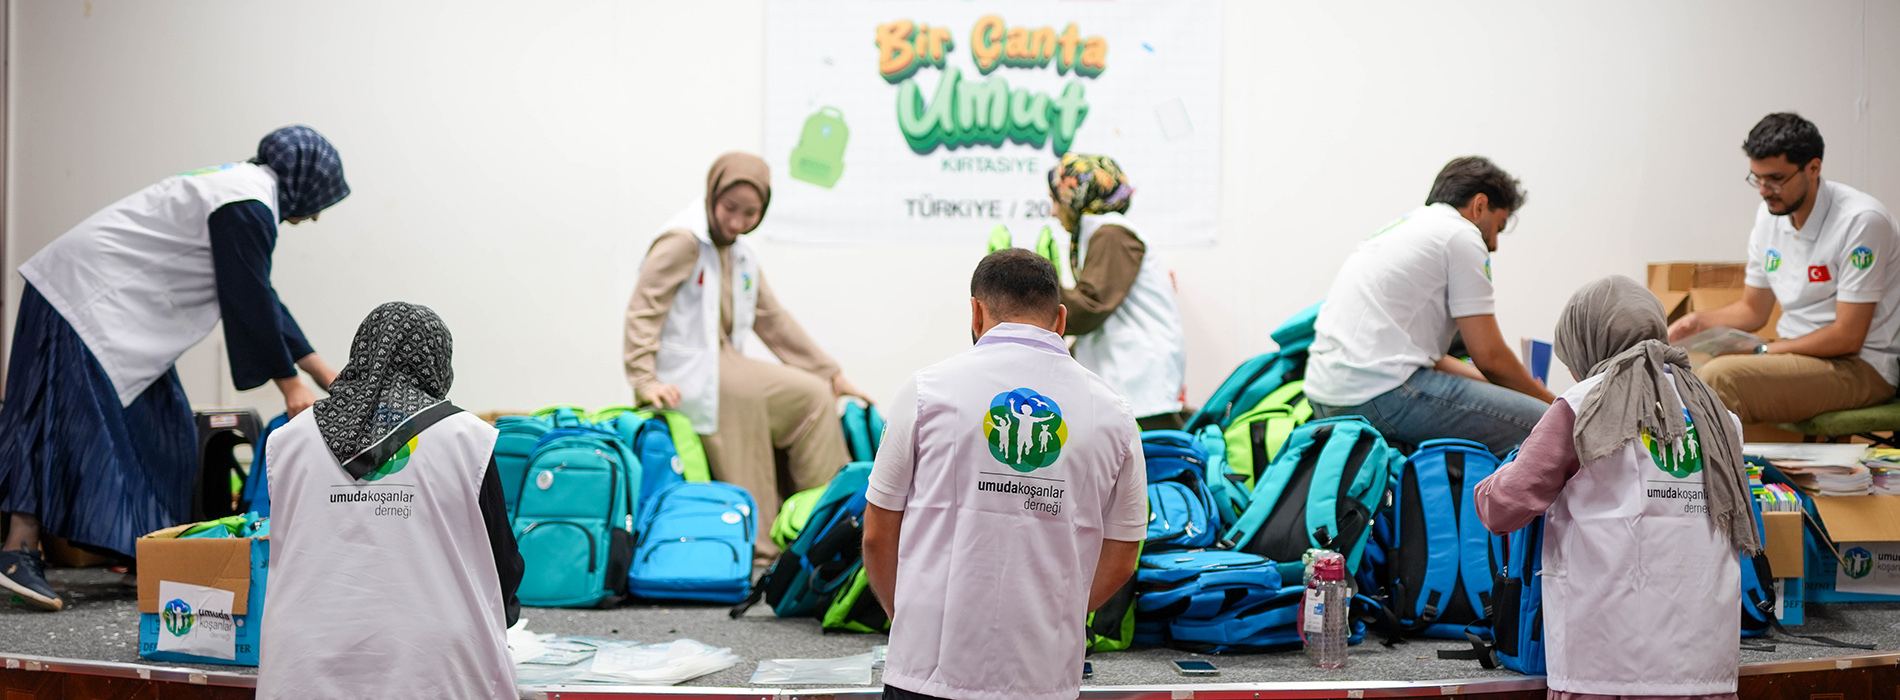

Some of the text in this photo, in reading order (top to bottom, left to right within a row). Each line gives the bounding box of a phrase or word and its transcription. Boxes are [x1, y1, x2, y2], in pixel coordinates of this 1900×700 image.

[875, 14, 1108, 83] Bir Çanta
[896, 66, 1090, 156] Umut
[904, 193, 1051, 218] TÜRKİYE / 20
[330, 490, 414, 504] umudakoşanlar
[978, 480, 1065, 499] umudakoşanlar
[1647, 487, 1709, 502] umudakoşanla
[374, 504, 412, 519] derneği
[1023, 498, 1062, 516] derneği
[1878, 552, 1900, 561] umu
[198, 608, 231, 621] umuda
